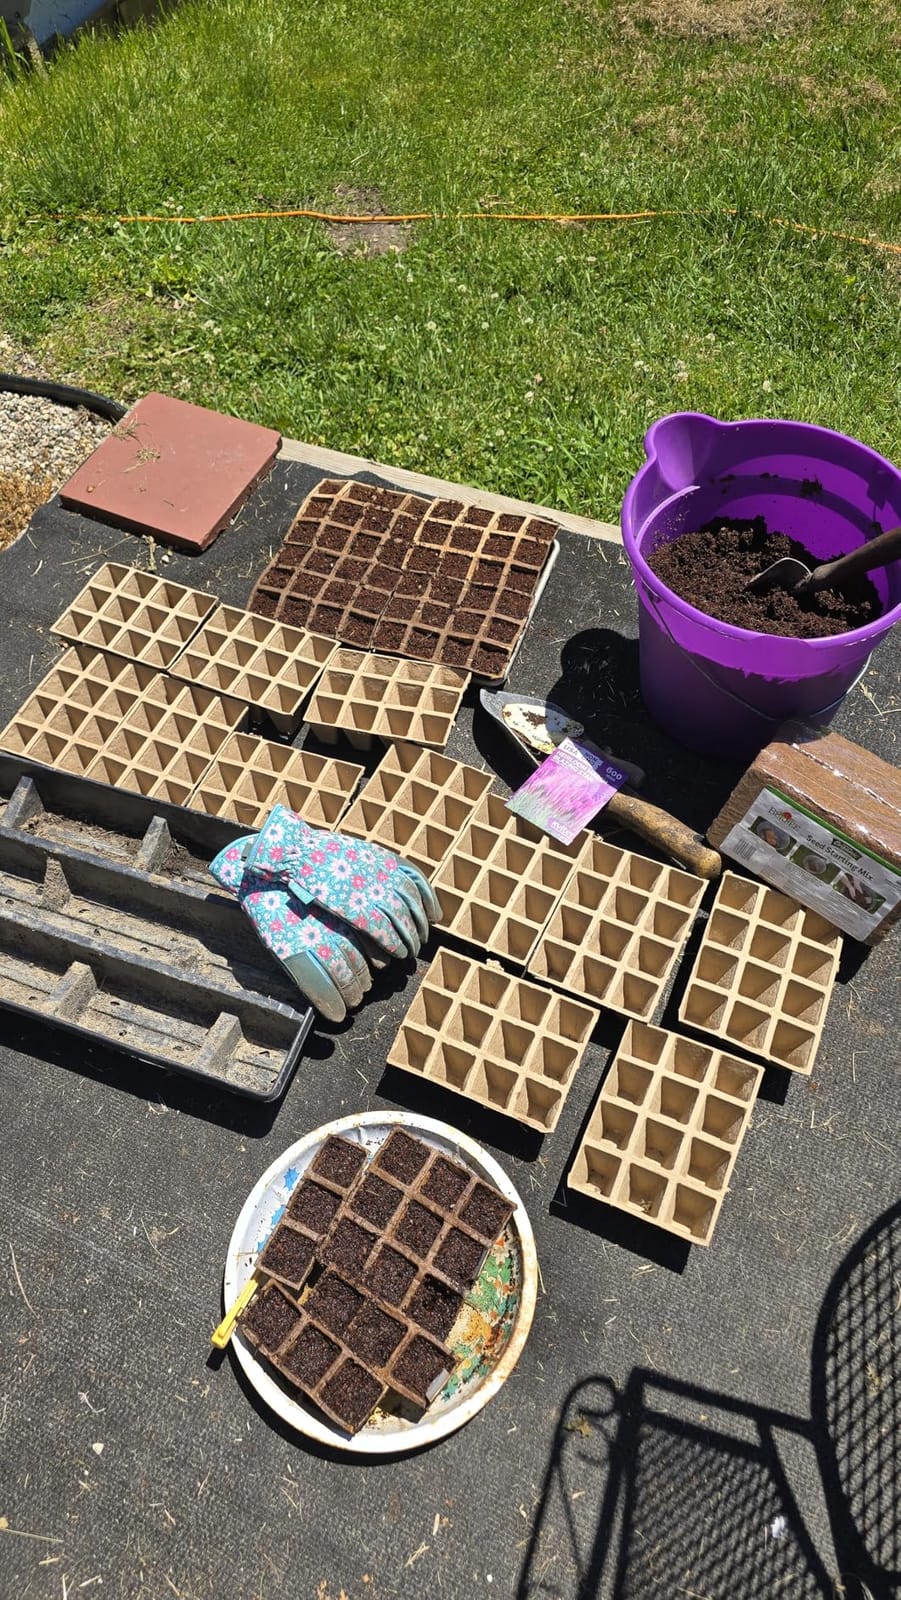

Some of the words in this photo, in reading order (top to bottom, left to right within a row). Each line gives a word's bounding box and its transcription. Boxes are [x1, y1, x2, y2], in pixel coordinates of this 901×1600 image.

[606, 767, 622, 780] 600
[806, 834, 826, 850] Seed
[825, 846, 859, 872] Starting
[857, 868, 873, 881] Mix
